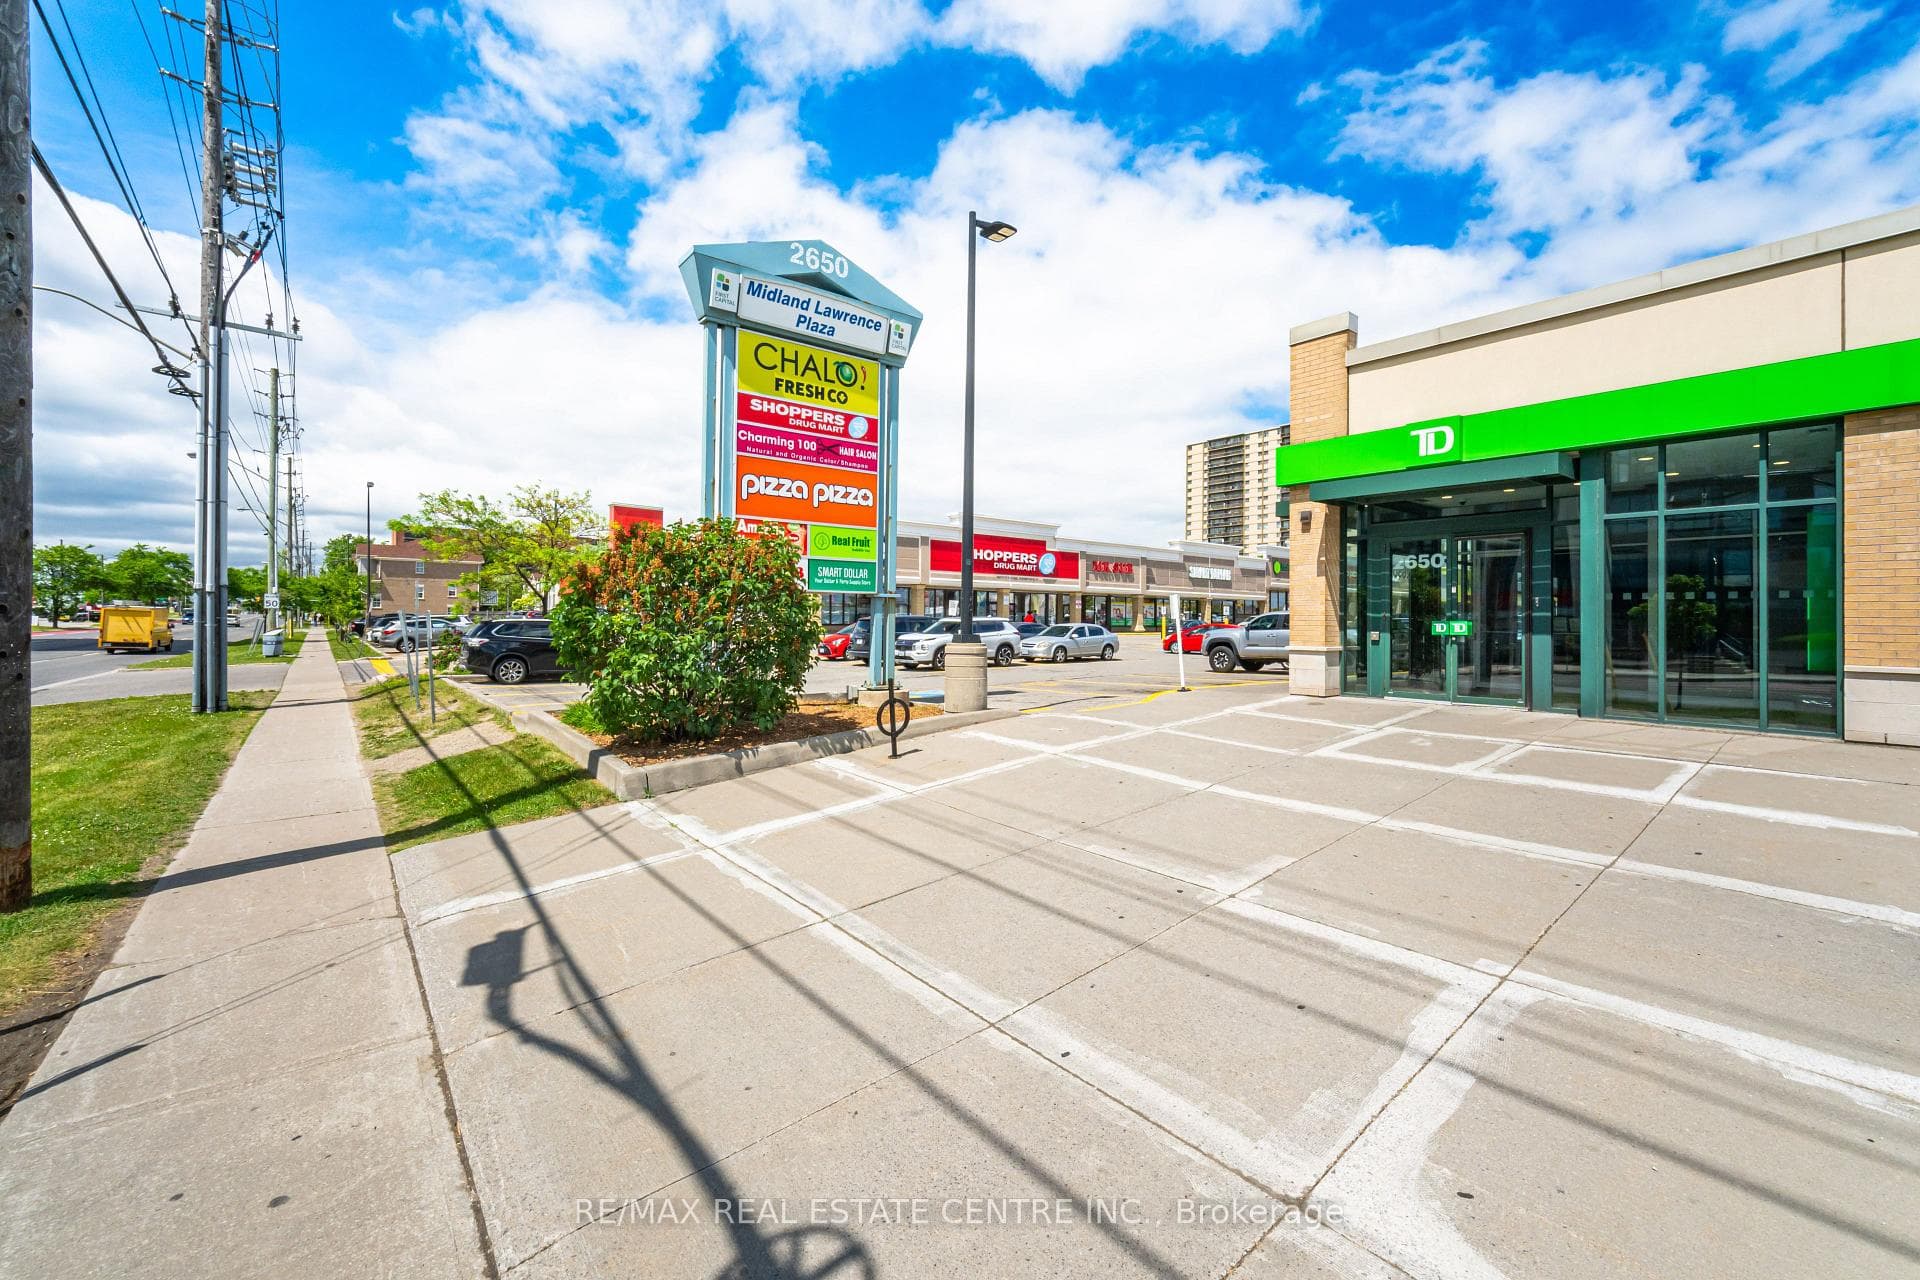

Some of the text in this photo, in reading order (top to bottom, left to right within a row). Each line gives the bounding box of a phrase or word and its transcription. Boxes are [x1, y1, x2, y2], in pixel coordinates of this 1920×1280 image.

[790, 242, 849, 278] 2650
[746, 281, 882, 332] Midland Lawrence
[796, 315, 836, 337] Plaza
[750, 398, 845, 426] SHOPPERS
[788, 418, 817, 430] DRUG
[818, 423, 844, 434] MART
[738, 429, 877, 460] Charming 100 HAIR SALON
[1410, 425, 1455, 457] TD
[746, 446, 773, 455] Natural
[775, 450, 788, 458] and
[790, 452, 817, 463] Organic
[831, 535, 870, 548] Real Fruit
[973, 548, 1038, 564] HOPPERS
[817, 566, 842, 577] SMART
[843, 567, 868, 579] DOLLAR
[993, 562, 1037, 571] DRUG MART
